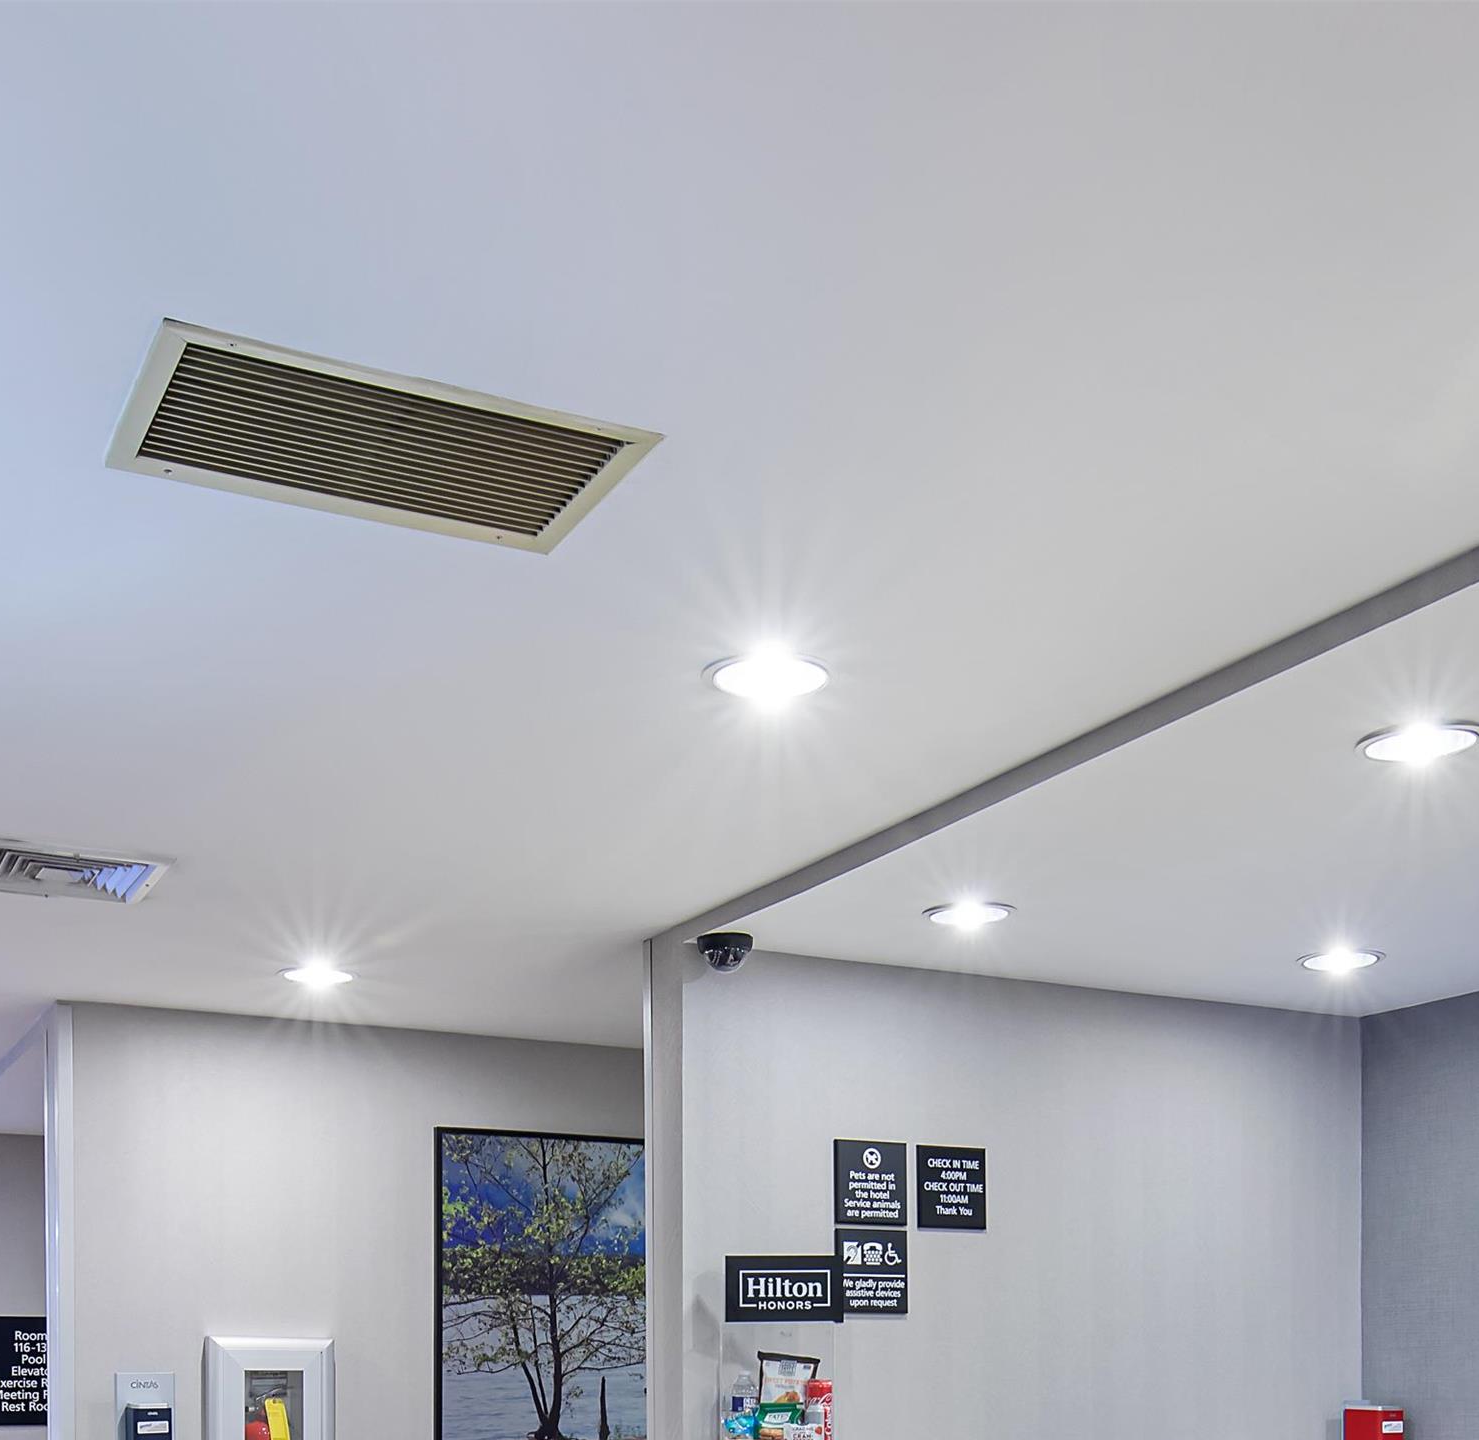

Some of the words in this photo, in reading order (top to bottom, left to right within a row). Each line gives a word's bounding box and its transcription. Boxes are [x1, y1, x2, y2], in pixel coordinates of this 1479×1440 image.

[927, 1158, 951, 1168] CHECK
[952, 1159, 961, 1169] IN
[962, 1160, 980, 1170] TIME
[849, 1170, 866, 1180] Pets
[867, 1173, 880, 1181] are
[881, 1173, 895, 1181] not
[940, 1170, 967, 1180] 4:00PM
[848, 1181, 887, 1190] permitted
[888, 1181, 896, 1190] in
[923, 1181, 948, 1191] CHECK
[949, 1182, 965, 1192] OUT
[966, 1183, 984, 1193] TIME
[855, 1190, 869, 1199] the
[870, 1190, 890, 1199] hotel
[940, 1194, 969, 1204] 11:00AM
[844, 1198, 871, 1208] Service
[872, 1200, 901, 1209] animals
[846, 1209, 860, 1217] are
[861, 1209, 899, 1219] permitted
[935, 1205, 957, 1215] Thank
[958, 1206, 973, 1216] You
[746, 1277, 823, 1298] Hilton
[855, 1278, 877, 1290] gladly
[878, 1279, 906, 1291] provide
[845, 1288, 874, 1297] assistive
[875, 1288, 901, 1298] devices
[758, 1301, 812, 1310] HONORS
[849, 1299, 869, 1308] upon
[870, 1299, 897, 1308] request
[21, 1354, 46, 1365] Pool
[1, 1401, 26, 1412] Rest
